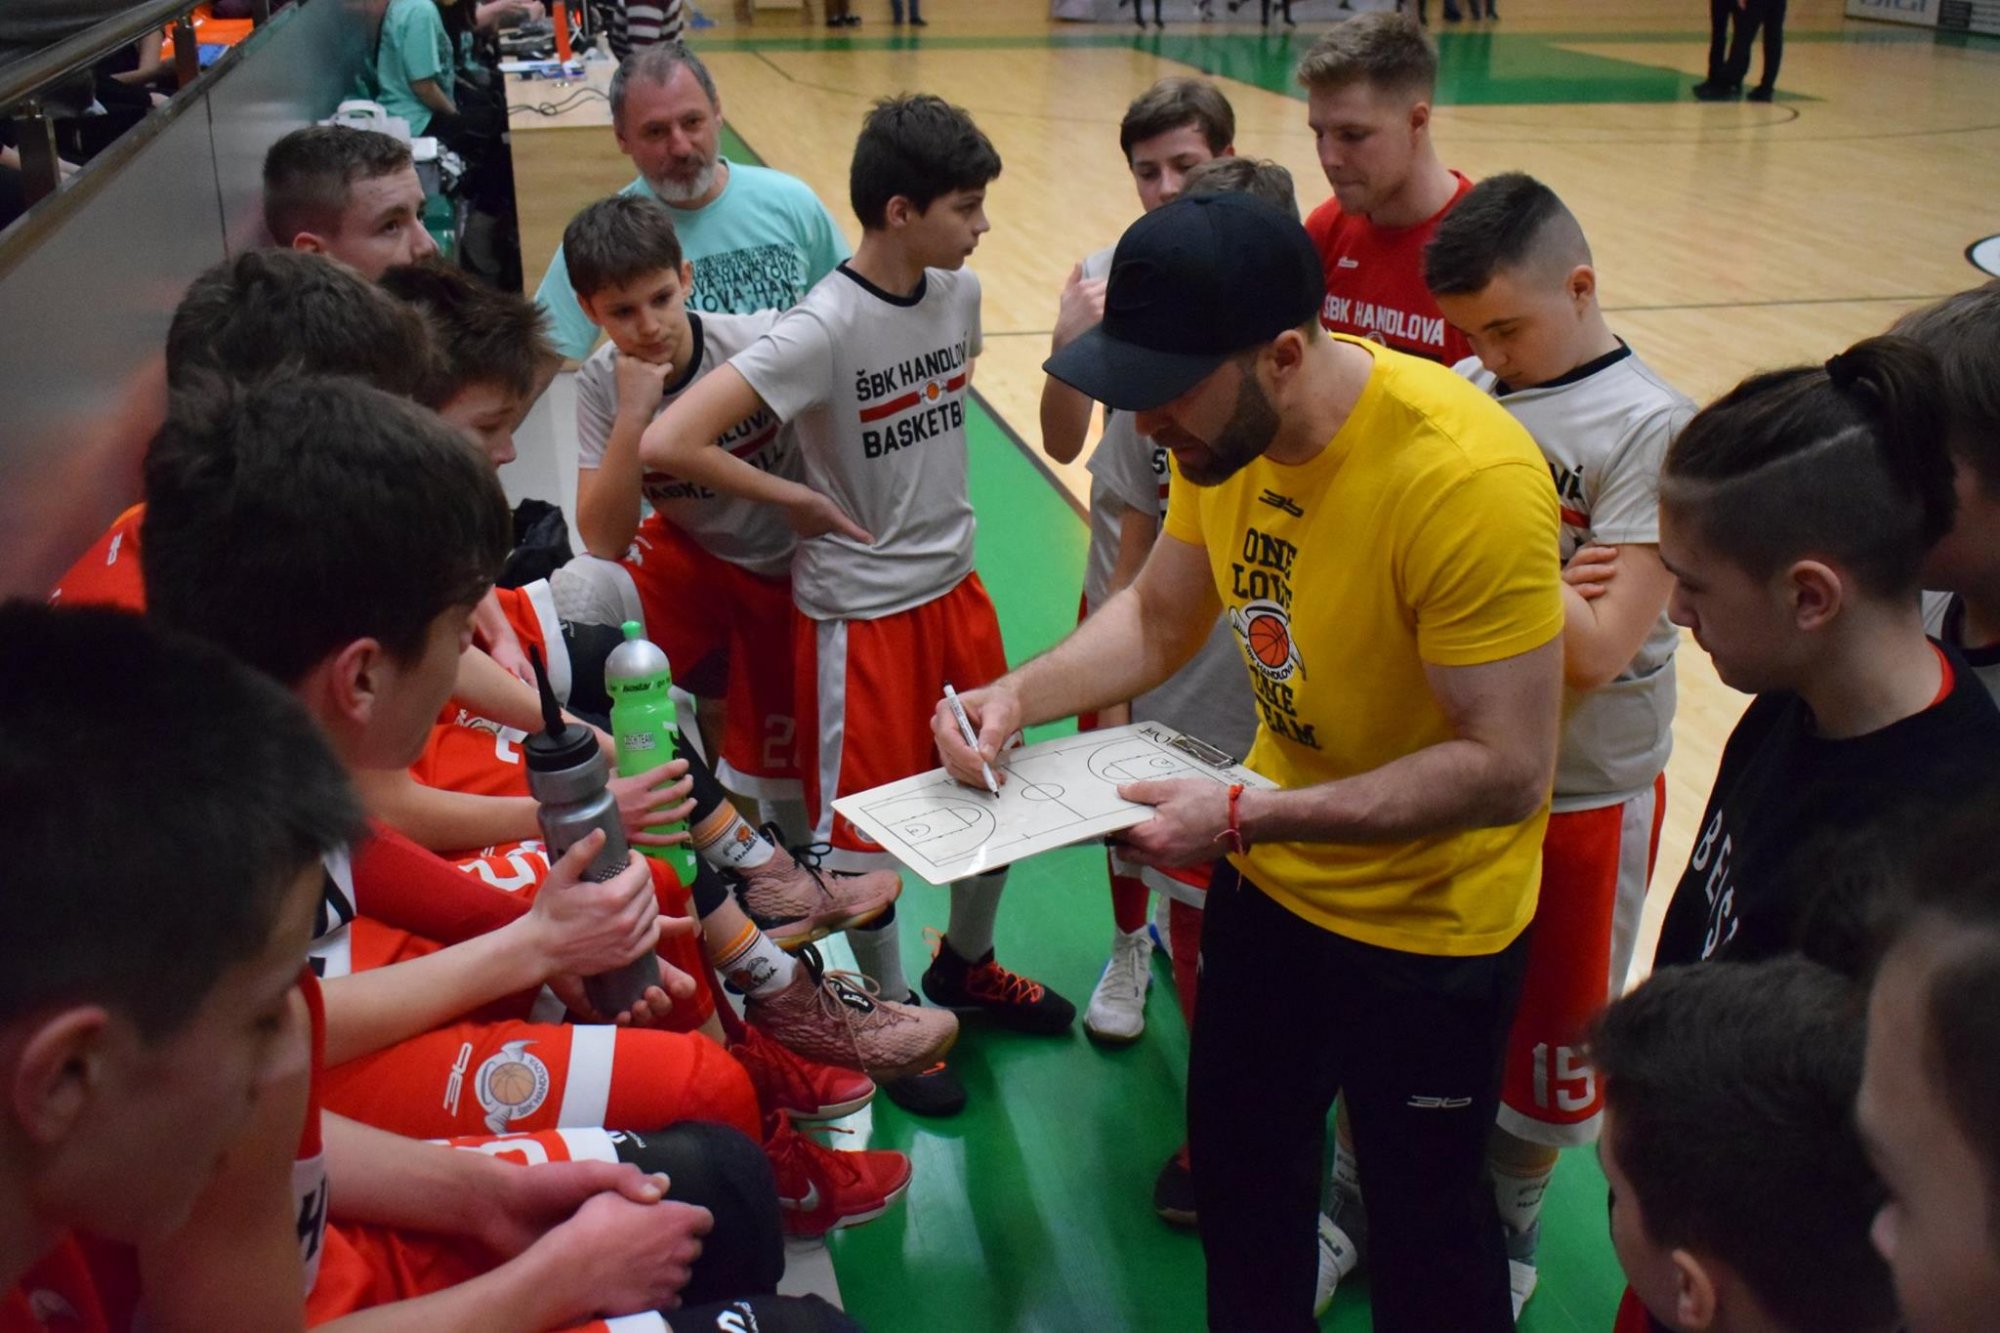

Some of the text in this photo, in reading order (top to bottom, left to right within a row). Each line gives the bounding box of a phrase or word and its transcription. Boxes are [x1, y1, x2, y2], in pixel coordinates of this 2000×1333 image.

[856, 332, 966, 402] ŠBK HANDLOV
[862, 400, 965, 459] BASKETB
[1243, 528, 1297, 581] ONE
[1532, 1042, 1596, 1112] 15
